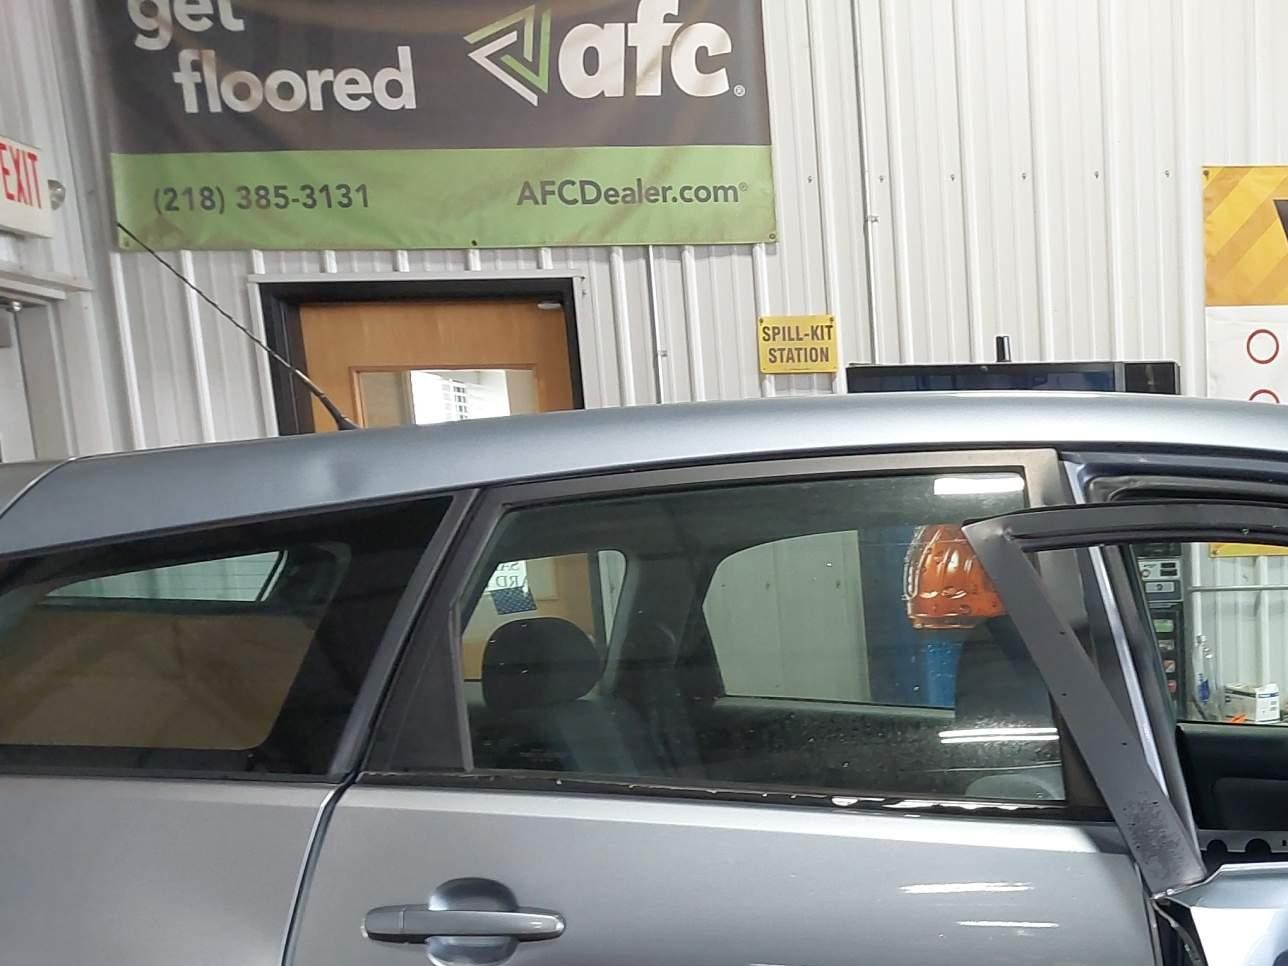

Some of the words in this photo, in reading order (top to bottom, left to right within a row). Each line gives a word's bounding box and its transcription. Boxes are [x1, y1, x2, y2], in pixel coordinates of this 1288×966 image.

[173, 46, 416, 113] floored
[0, 143, 41, 208] EXIT
[154, 187, 225, 214] (218)
[236, 184, 369, 210] 385-3131
[762, 325, 833, 341] SPILL-KIT
[768, 347, 829, 363] STATION
